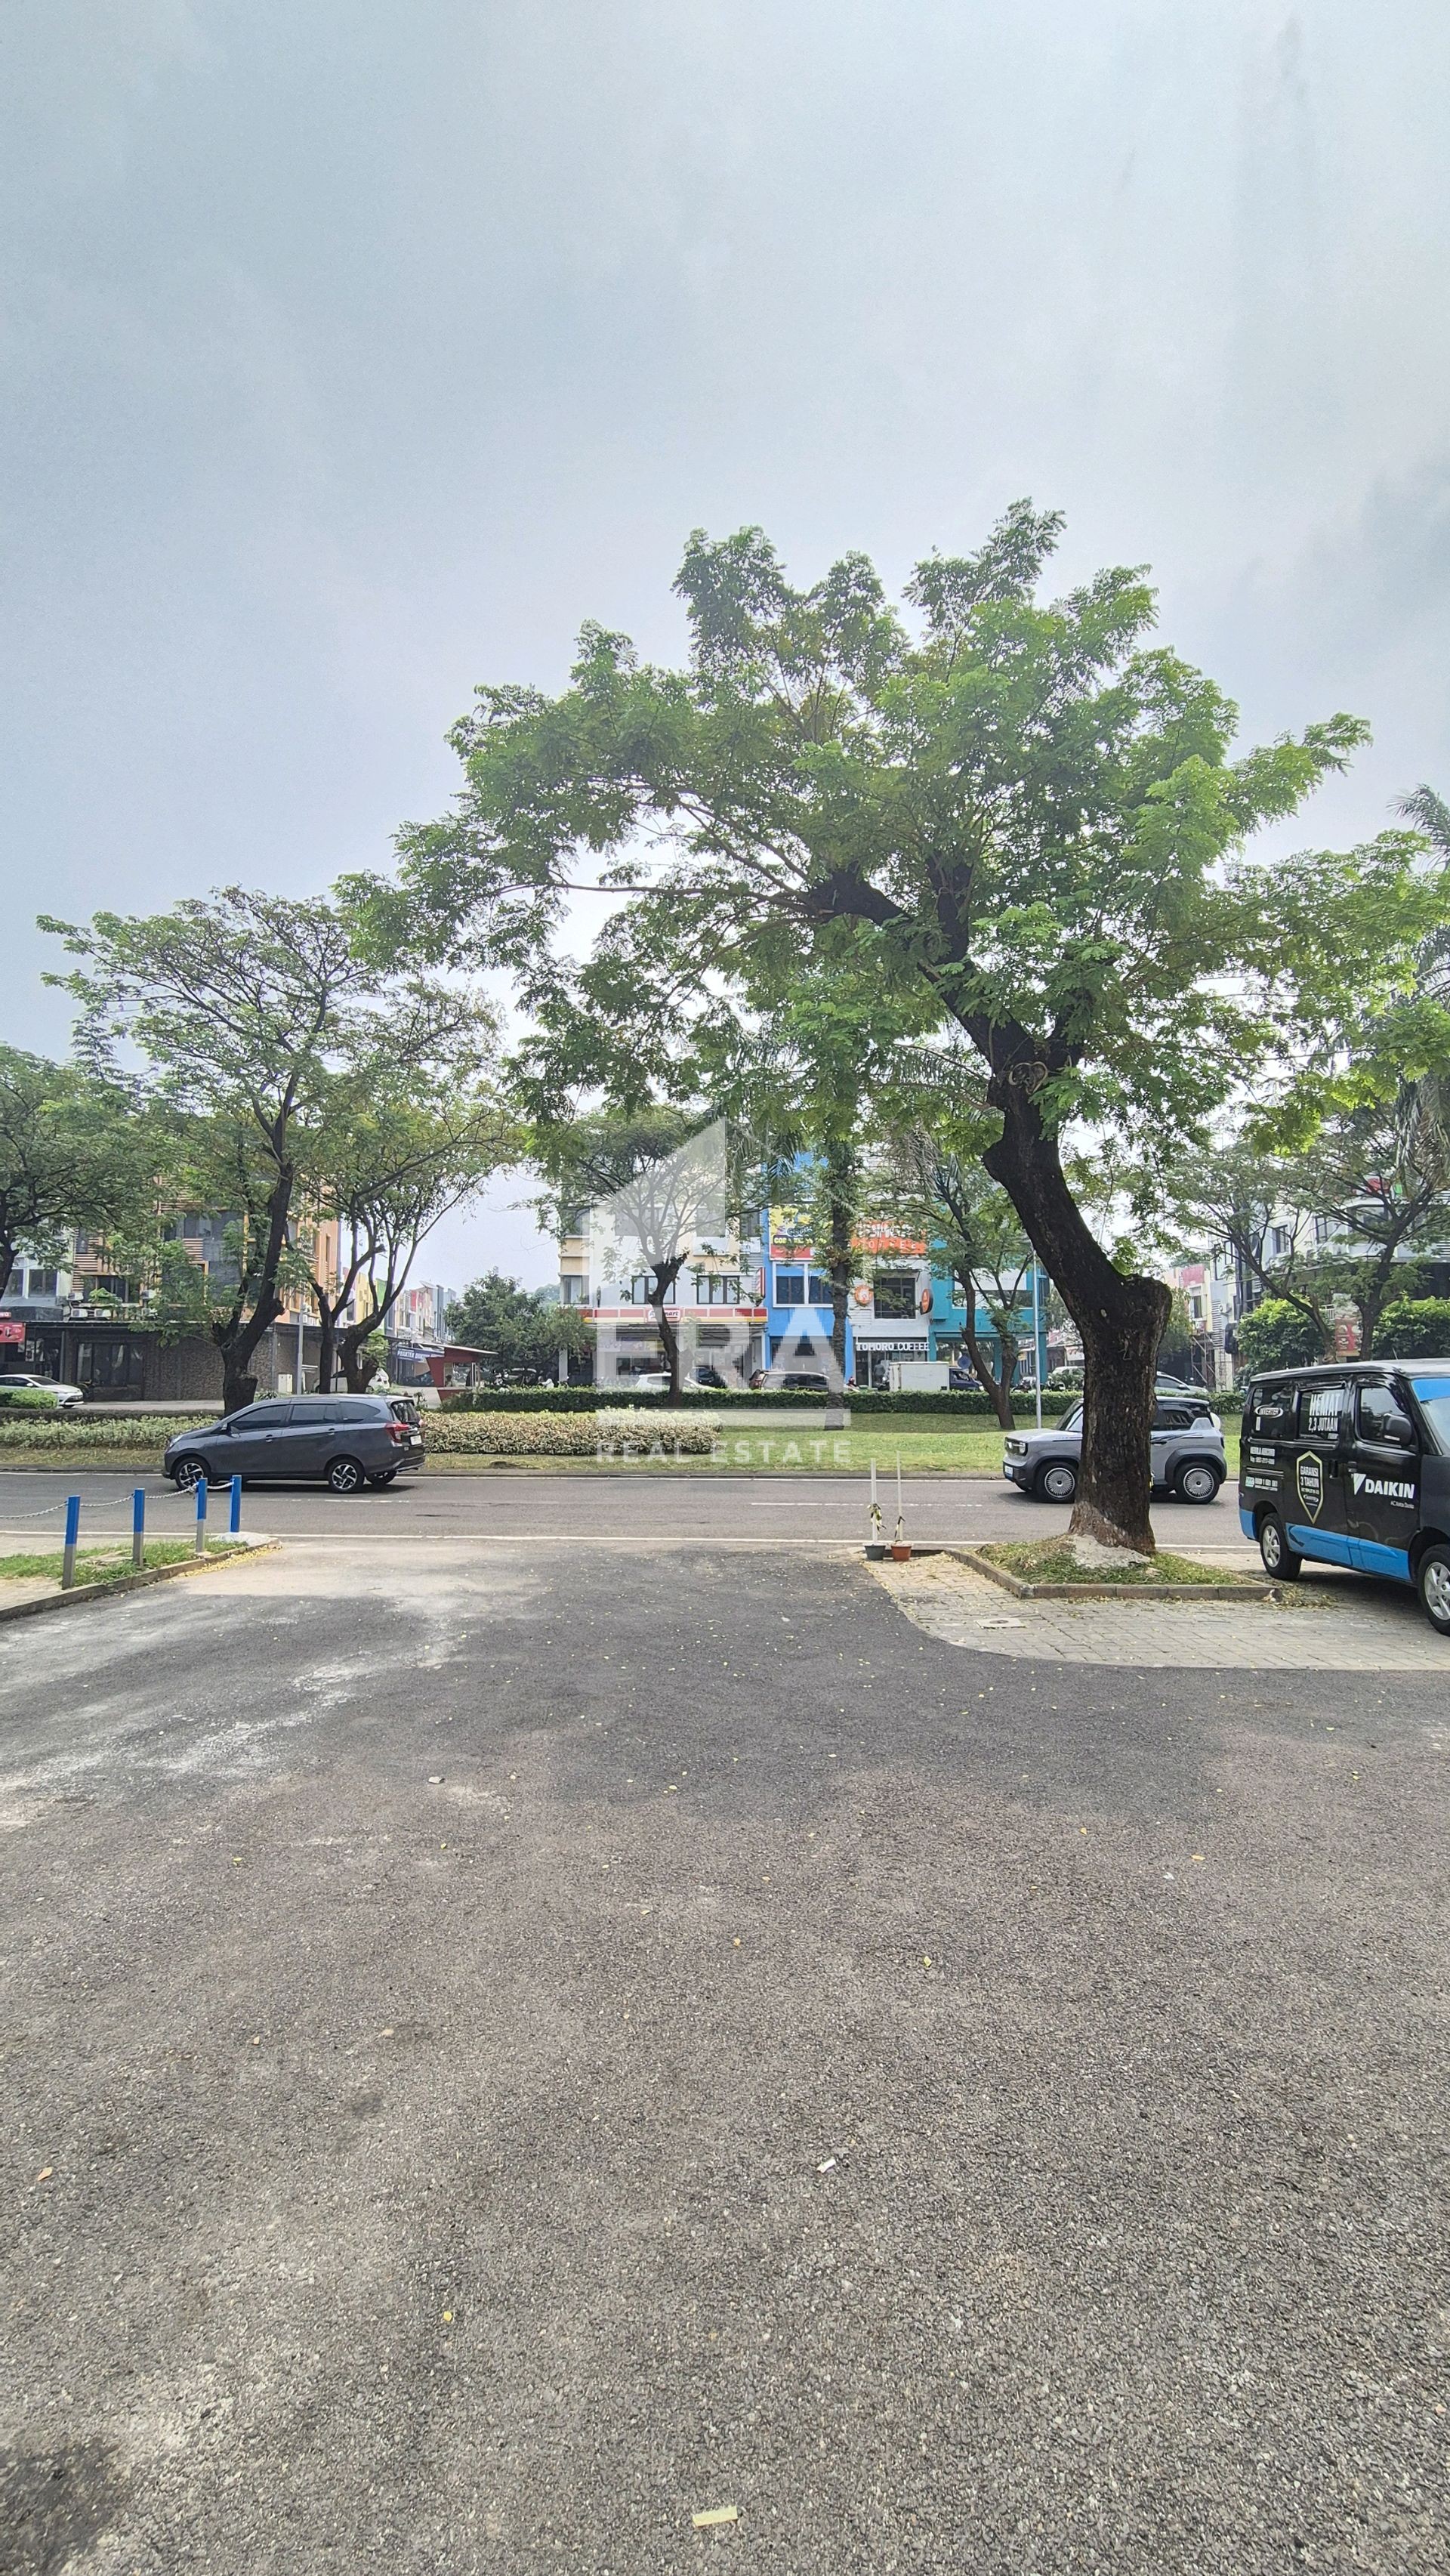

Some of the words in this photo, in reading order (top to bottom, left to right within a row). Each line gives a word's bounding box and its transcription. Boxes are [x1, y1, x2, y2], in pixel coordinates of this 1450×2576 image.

[856, 1342, 895, 1351] TOMORO
[897, 1342, 930, 1351] COFFEE
[1308, 1417, 1317, 1432] 2,3
[1318, 1417, 1338, 1432] JUTAAN
[1300, 1476, 1303, 1486] 3
[1365, 1479, 1415, 1499] DAIKIN
